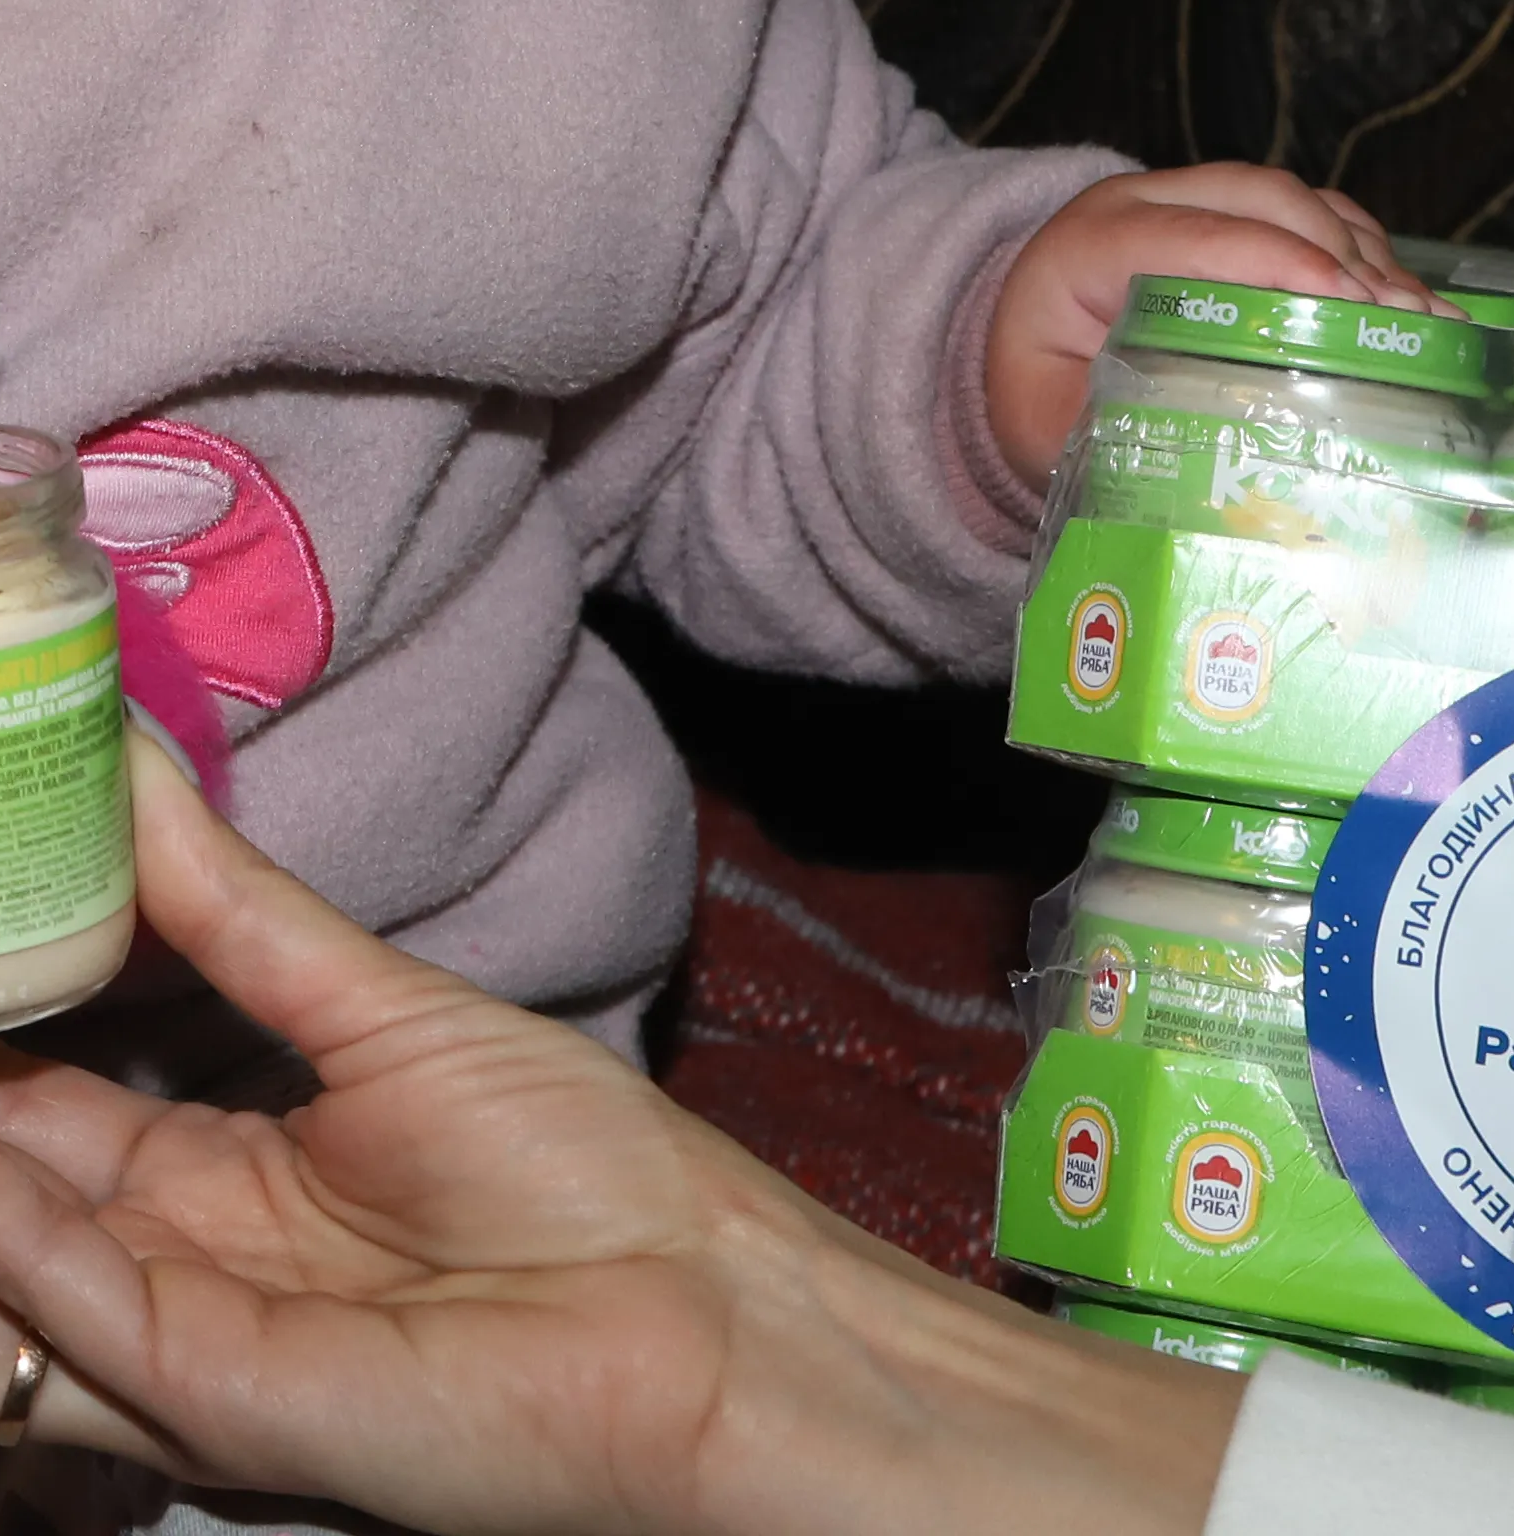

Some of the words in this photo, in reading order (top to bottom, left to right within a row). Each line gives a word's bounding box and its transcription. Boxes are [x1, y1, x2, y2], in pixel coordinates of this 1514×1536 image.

[1356, 317, 1422, 357] koko
[1082, 643, 1112, 658] НАША
[1080, 657, 1111, 674] РЯБА
[1202, 1120, 1275, 1183] гарантовано
[1067, 1157, 1096, 1175] НАША
[1065, 1171, 1096, 1191] РЯБА
[1193, 1183, 1240, 1202] НАША
[1190, 1197, 1240, 1219] РЯБА
